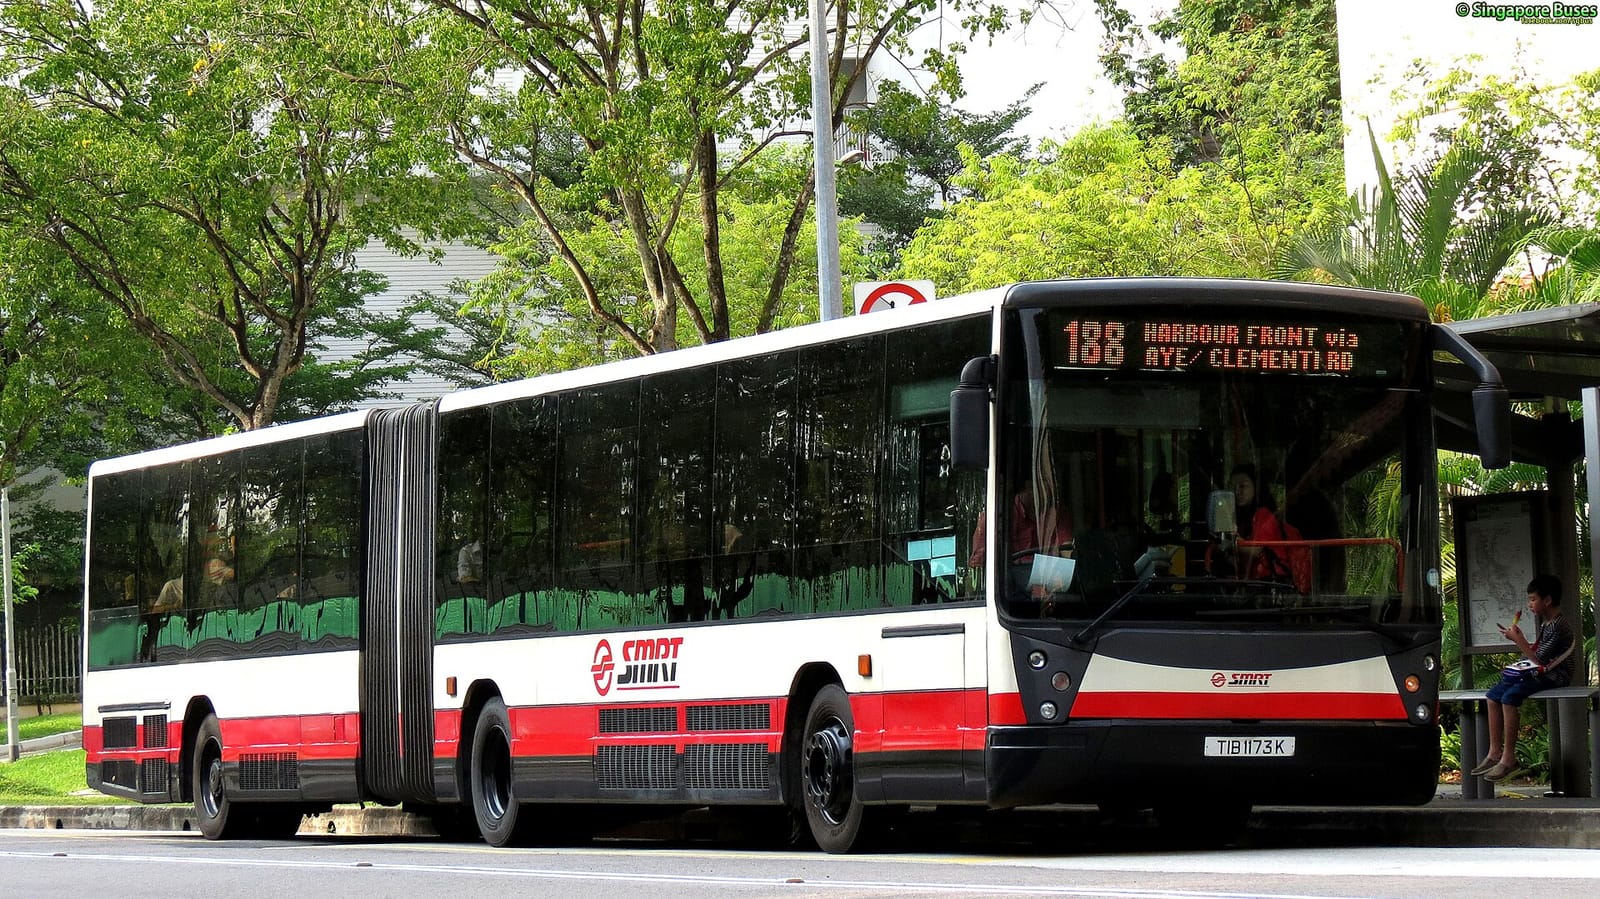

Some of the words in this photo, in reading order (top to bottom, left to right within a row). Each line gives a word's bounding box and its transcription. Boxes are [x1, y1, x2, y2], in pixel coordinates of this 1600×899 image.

[1063, 320, 1125, 365] 188
[1144, 322, 1239, 345] HARBOUR
[1247, 325, 1319, 347] FRONT
[1325, 328, 1359, 348] via
[1210, 348, 1320, 370] CLEMENTI
[1327, 351, 1354, 371] RD
[617, 637, 684, 685] SMRT
[1228, 673, 1273, 685] SMRT
[1217, 740, 1284, 755] TIB1173K
